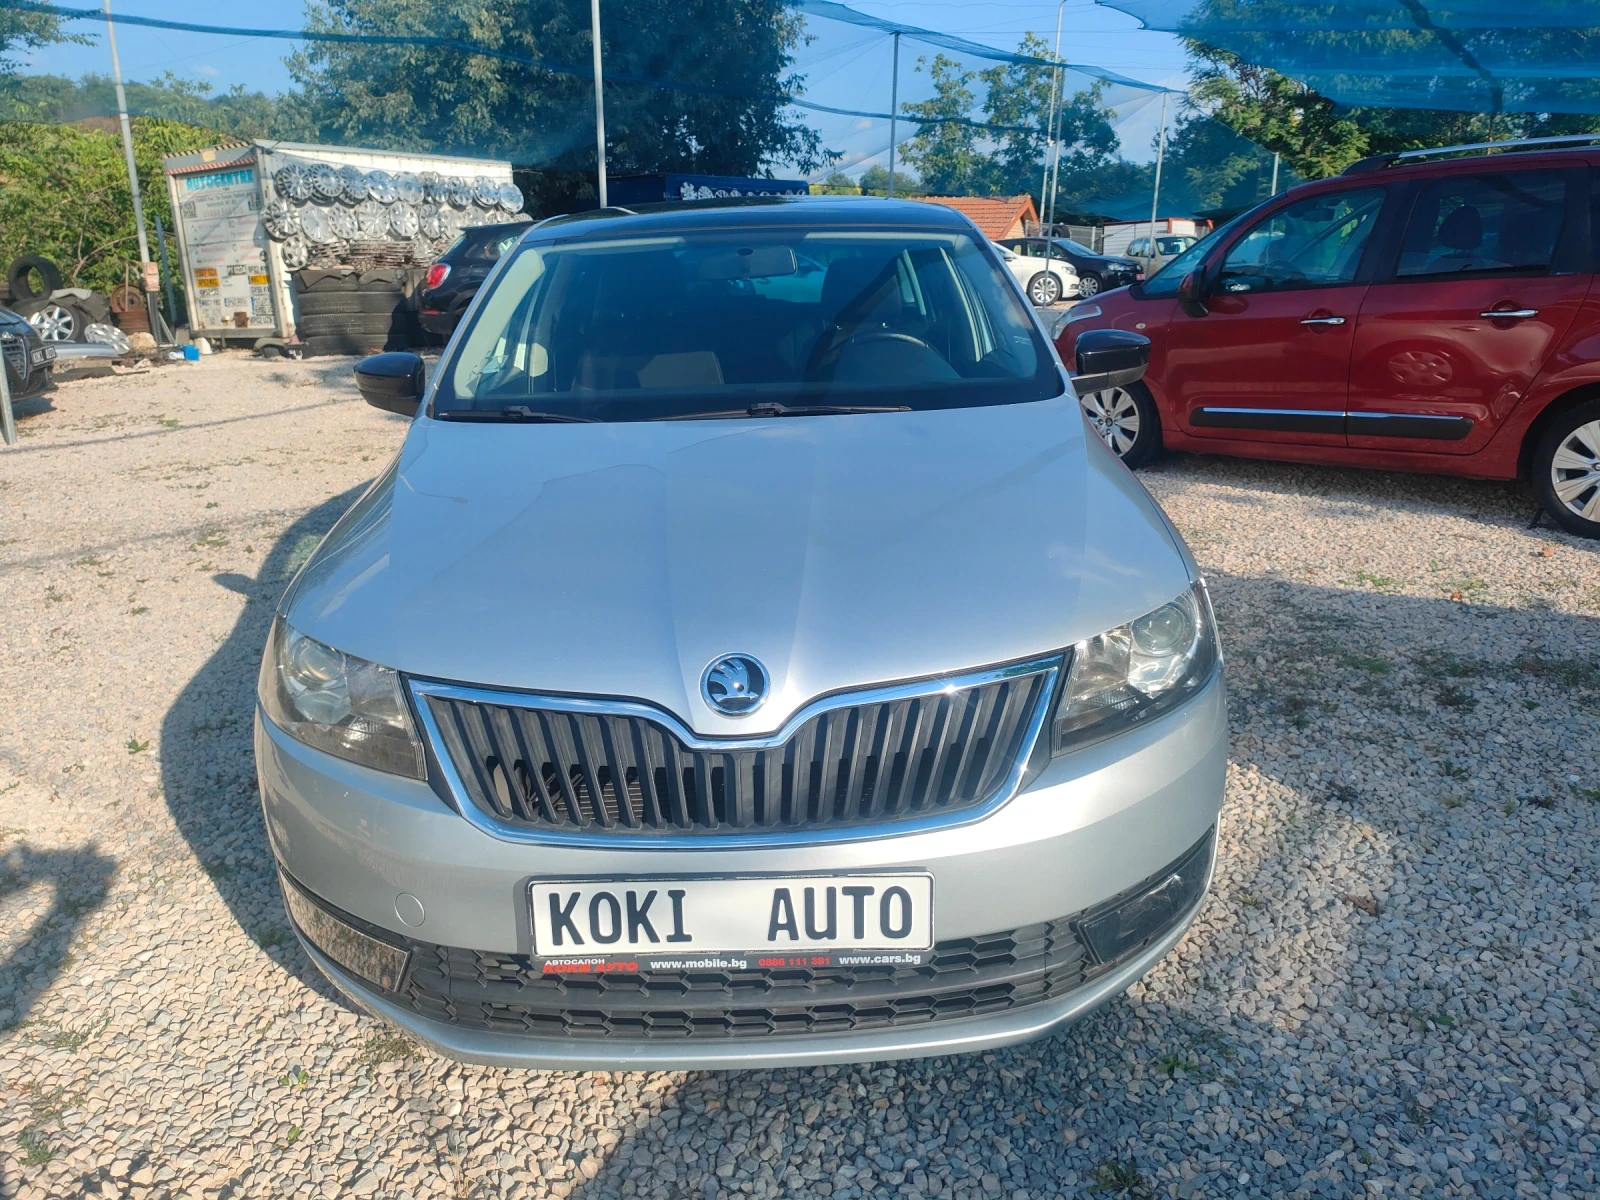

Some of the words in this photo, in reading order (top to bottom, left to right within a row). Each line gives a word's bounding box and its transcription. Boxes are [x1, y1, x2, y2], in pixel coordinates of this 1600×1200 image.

[186, 169, 254, 191] AUTOCENTRE
[548, 889, 693, 946] KOKI
[767, 886, 913, 942] AUTO
[545, 958, 605, 966] АВТОСАЛОН
[650, 958, 748, 971] www.mobile.bg
[788, 957, 807, 966] 111
[839, 953, 921, 966] www.cars.bg
[595, 961, 639, 973] АУТО
